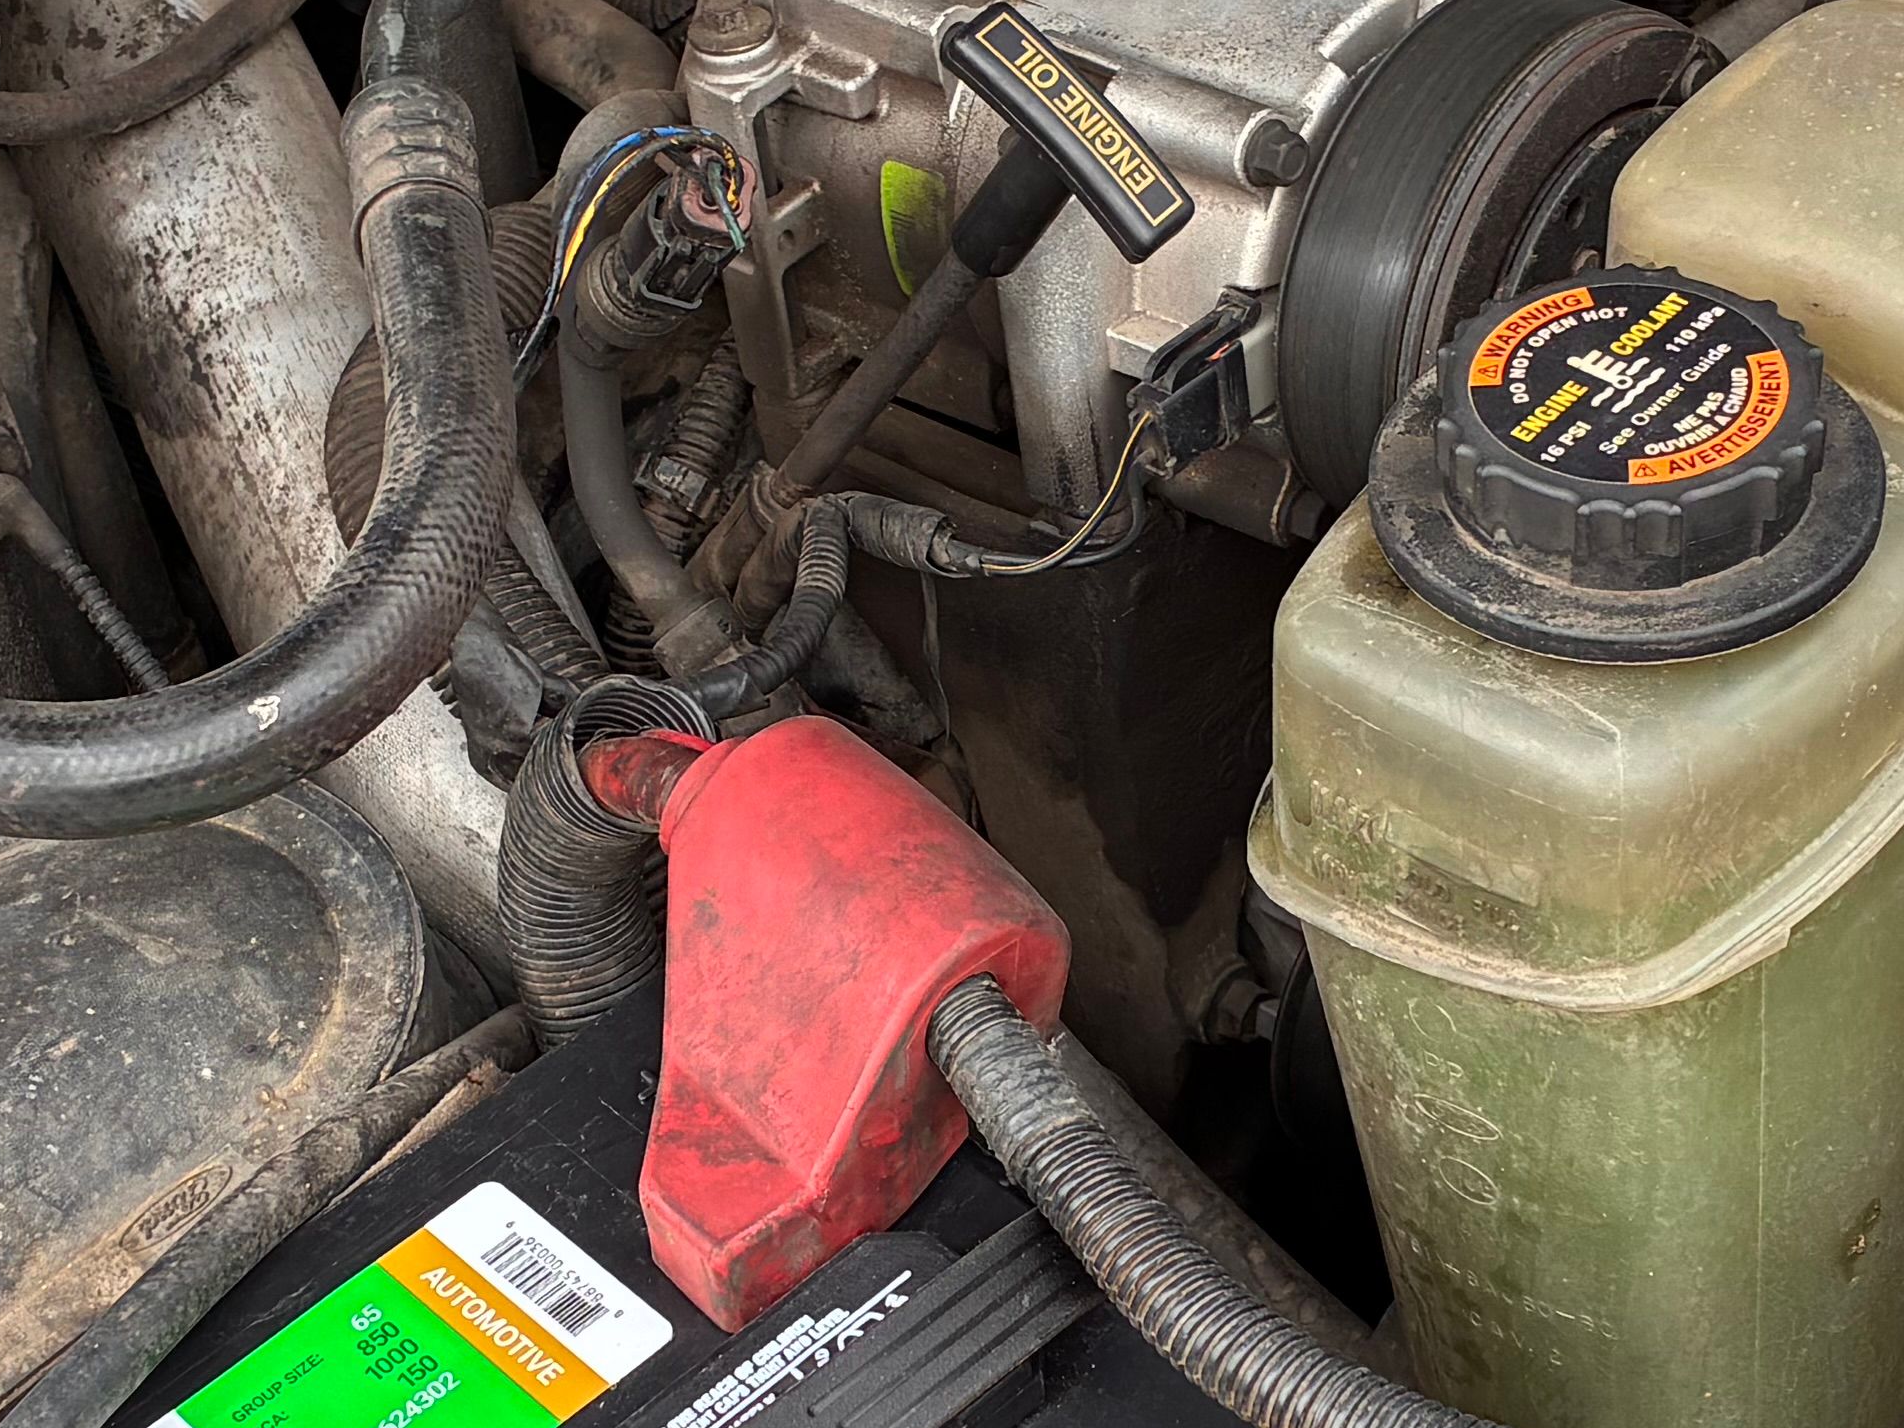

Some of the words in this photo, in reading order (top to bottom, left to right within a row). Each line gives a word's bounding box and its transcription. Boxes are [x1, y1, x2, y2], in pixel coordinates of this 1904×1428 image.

[1014, 39, 1060, 89] OIL
[1053, 84, 1156, 195] ENGINE
[1482, 294, 1583, 359] WARNING
[1528, 318, 1579, 350] OPEN
[1581, 307, 1628, 324] HOT
[1665, 328, 1697, 353] 110
[1695, 305, 1727, 334] kPa
[1509, 352, 1533, 380] NOT
[1510, 380, 1590, 443] ENGINE
[1609, 291, 1689, 356] COOLANT
[1509, 383, 1530, 404] DO
[1599, 428, 1636, 455] See
[1631, 383, 1686, 427] Owner
[1681, 343, 1732, 383] Guide
[1644, 424, 1719, 457] OUVRIR
[1723, 368, 1749, 414] CHAUD
[1667, 359, 1783, 476] AVERTISSEMENT
[1673, 412, 1702, 434] NE
[1698, 391, 1725, 421] PAS
[1541, 443, 1566, 463] 16
[1561, 421, 1593, 447] PSI
[356, 1321, 400, 1357] 850
[419, 1264, 564, 1387] AUTOMOTIVE
[231, 1381, 283, 1423] GROUP
[284, 1354, 324, 1385] SIZE:
[348, 1300, 387, 1338] 65
[365, 1338, 419, 1380] 1000
[397, 1355, 439, 1387] 150
